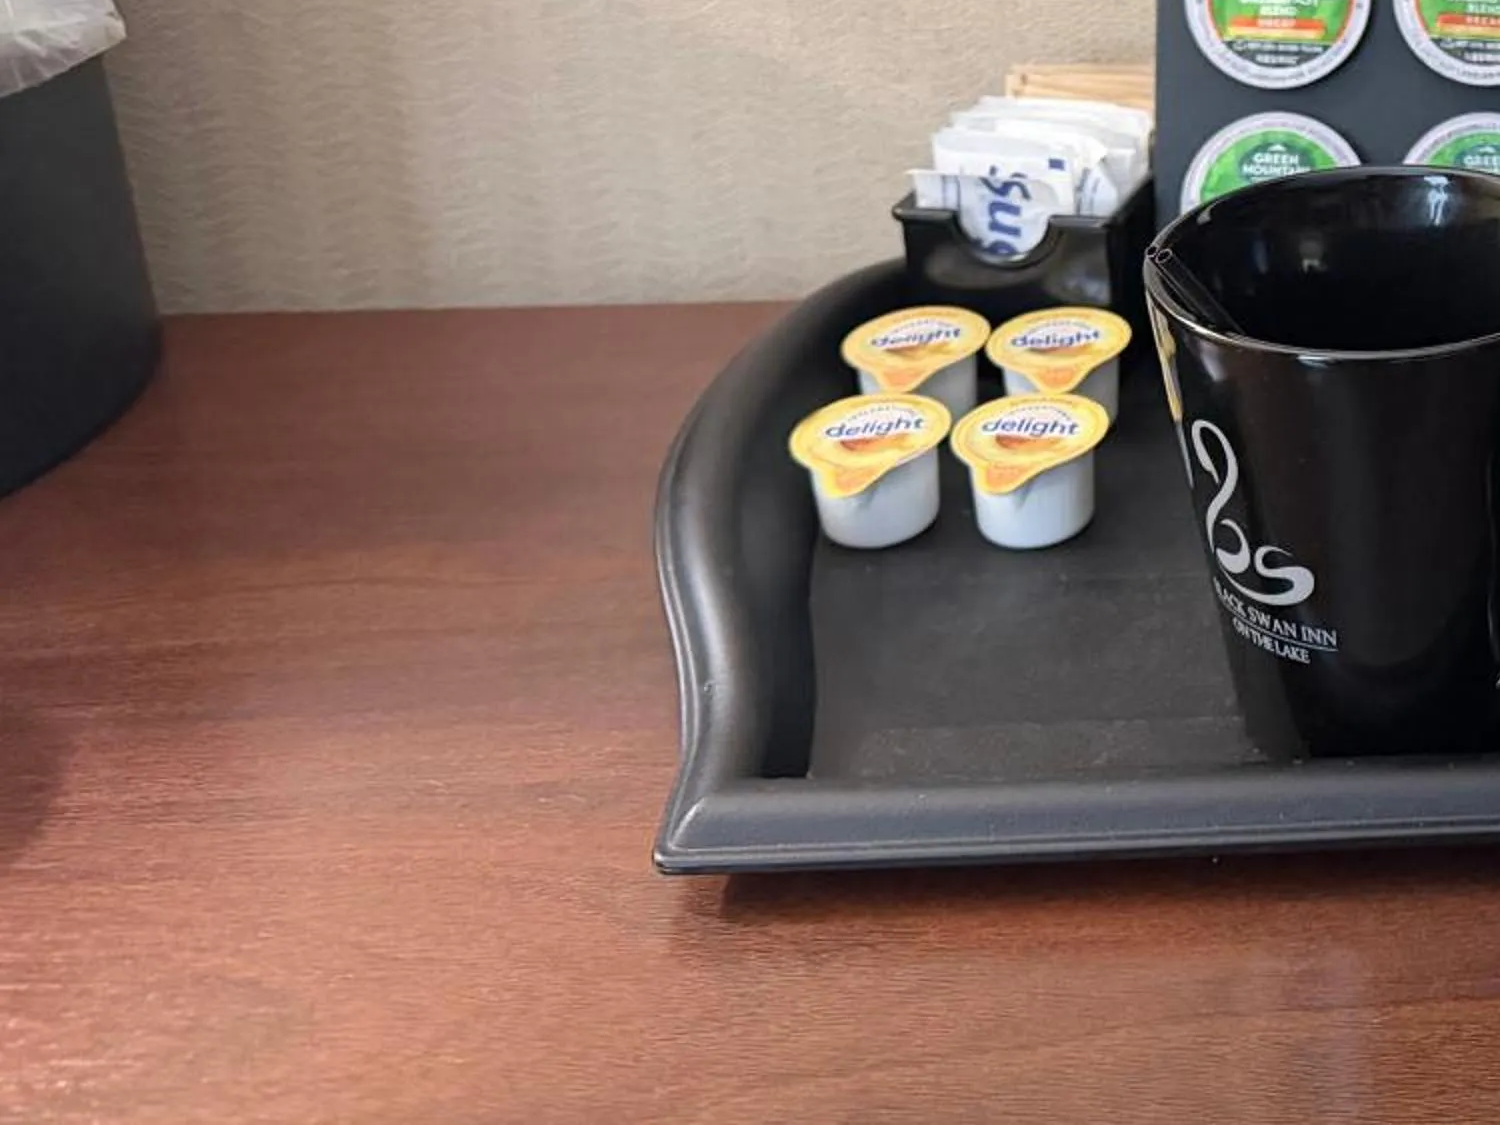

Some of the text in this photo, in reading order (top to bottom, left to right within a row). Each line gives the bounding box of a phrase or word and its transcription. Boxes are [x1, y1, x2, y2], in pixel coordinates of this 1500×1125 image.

[1252, 153, 1300, 165] GREEN
[870, 327, 961, 347] delight
[1010, 329, 1100, 348] delight
[825, 417, 925, 437] delight
[981, 418, 1080, 437] delight
[1247, 606, 1298, 638] SWAN
[1301, 625, 1337, 646] INN
[1274, 640, 1312, 664] LAKE
